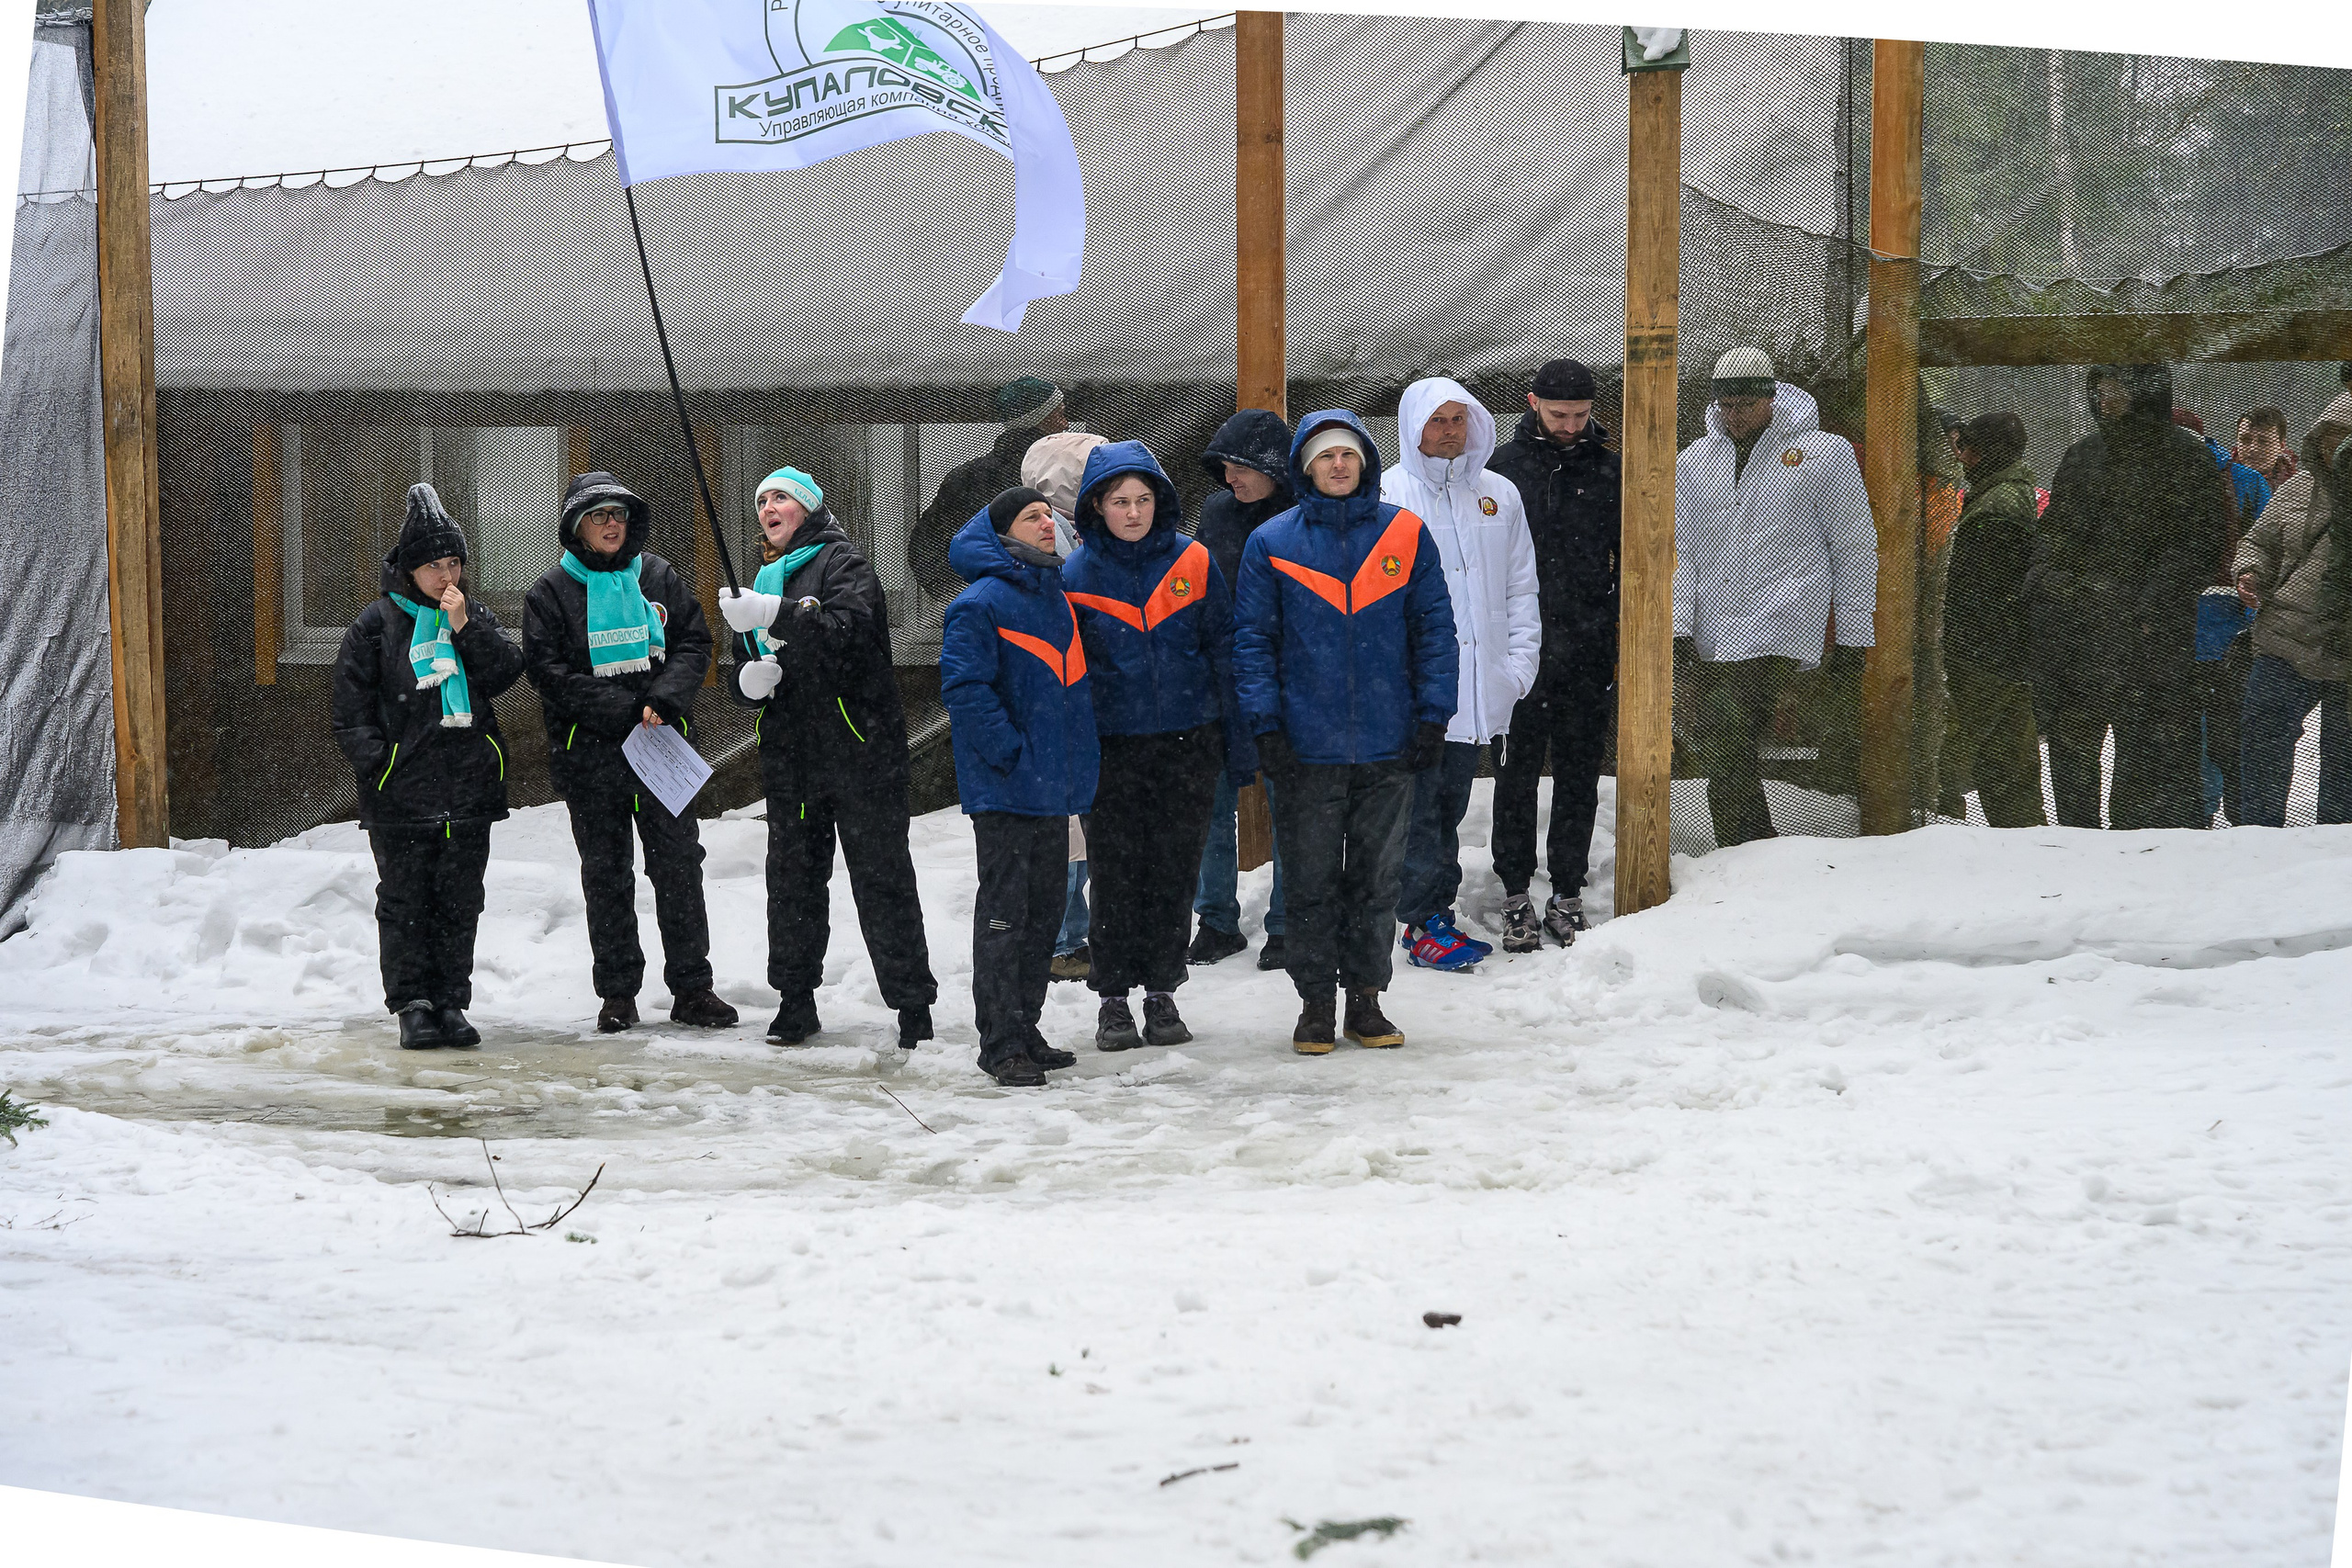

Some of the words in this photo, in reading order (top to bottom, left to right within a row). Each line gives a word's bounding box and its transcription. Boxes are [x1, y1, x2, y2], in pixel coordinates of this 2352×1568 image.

[894, 0, 989, 53] итарное
[759, 96, 865, 140] Управляющая
[588, 627, 645, 647] УПАЛОВСКОЕ
